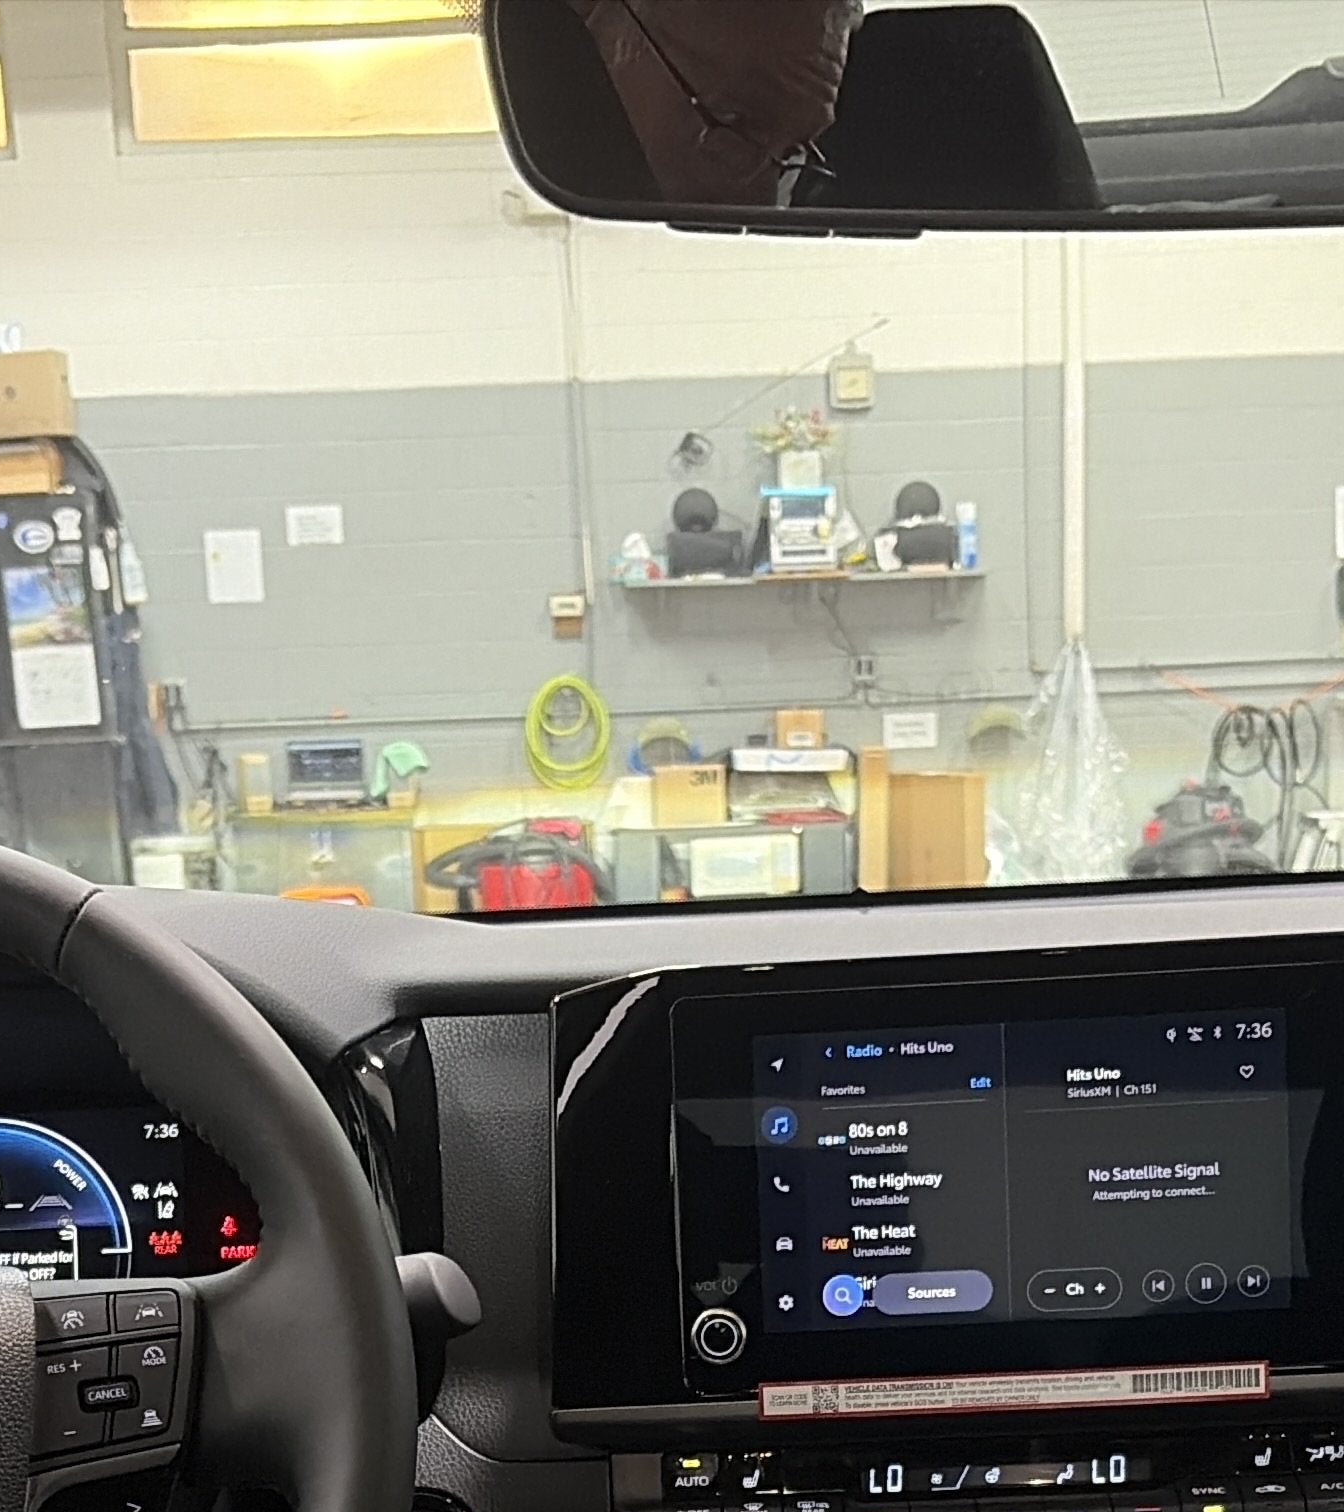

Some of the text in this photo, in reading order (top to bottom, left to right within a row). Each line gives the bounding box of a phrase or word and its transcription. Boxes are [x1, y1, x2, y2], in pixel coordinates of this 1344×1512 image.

[1236, 1022, 1272, 1039] 7:36
[846, 1041, 954, 1058] Radio Hits Uno
[1066, 1067, 1121, 1082] Hits Uno
[970, 1077, 992, 1089] Edit
[821, 1085, 866, 1096] Favorites
[1067, 1083, 1156, 1098] SiriusXM Ch 151
[143, 1123, 179, 1139] 7:36
[848, 1121, 908, 1138] 80s on 8
[849, 1143, 908, 1155] Unavailable
[53, 1158, 87, 1192] POWER
[1088, 1161, 1220, 1182] No Satellite Signal
[850, 1172, 943, 1190] The Highway
[851, 1194, 910, 1207] Unavailable
[1092, 1188, 1150, 1201] Attempting
[1152, 1188, 1163, 1198] to
[852, 1224, 916, 1240] The Heat
[154, 1245, 177, 1254] REAR
[220, 1245, 257, 1259] PARK
[853, 1245, 912, 1258] Unavailable
[21, 1251, 58, 1265] Parked
[58, 1250, 73, 1262] for
[29, 1267, 56, 1280] OFF?
[907, 1286, 956, 1299] Sources
[1065, 1283, 1084, 1295] Ch
[142, 1356, 167, 1366] MODE
[47, 1362, 66, 1374] RES
[87, 1388, 127, 1401] CANCEL
[1091, 1455, 1126, 1484] LO
[674, 1476, 710, 1487] AUTO
[869, 1464, 903, 1493] LO
[1191, 1487, 1227, 1495] SYNC
[1321, 1482, 1344, 1491] A/C
